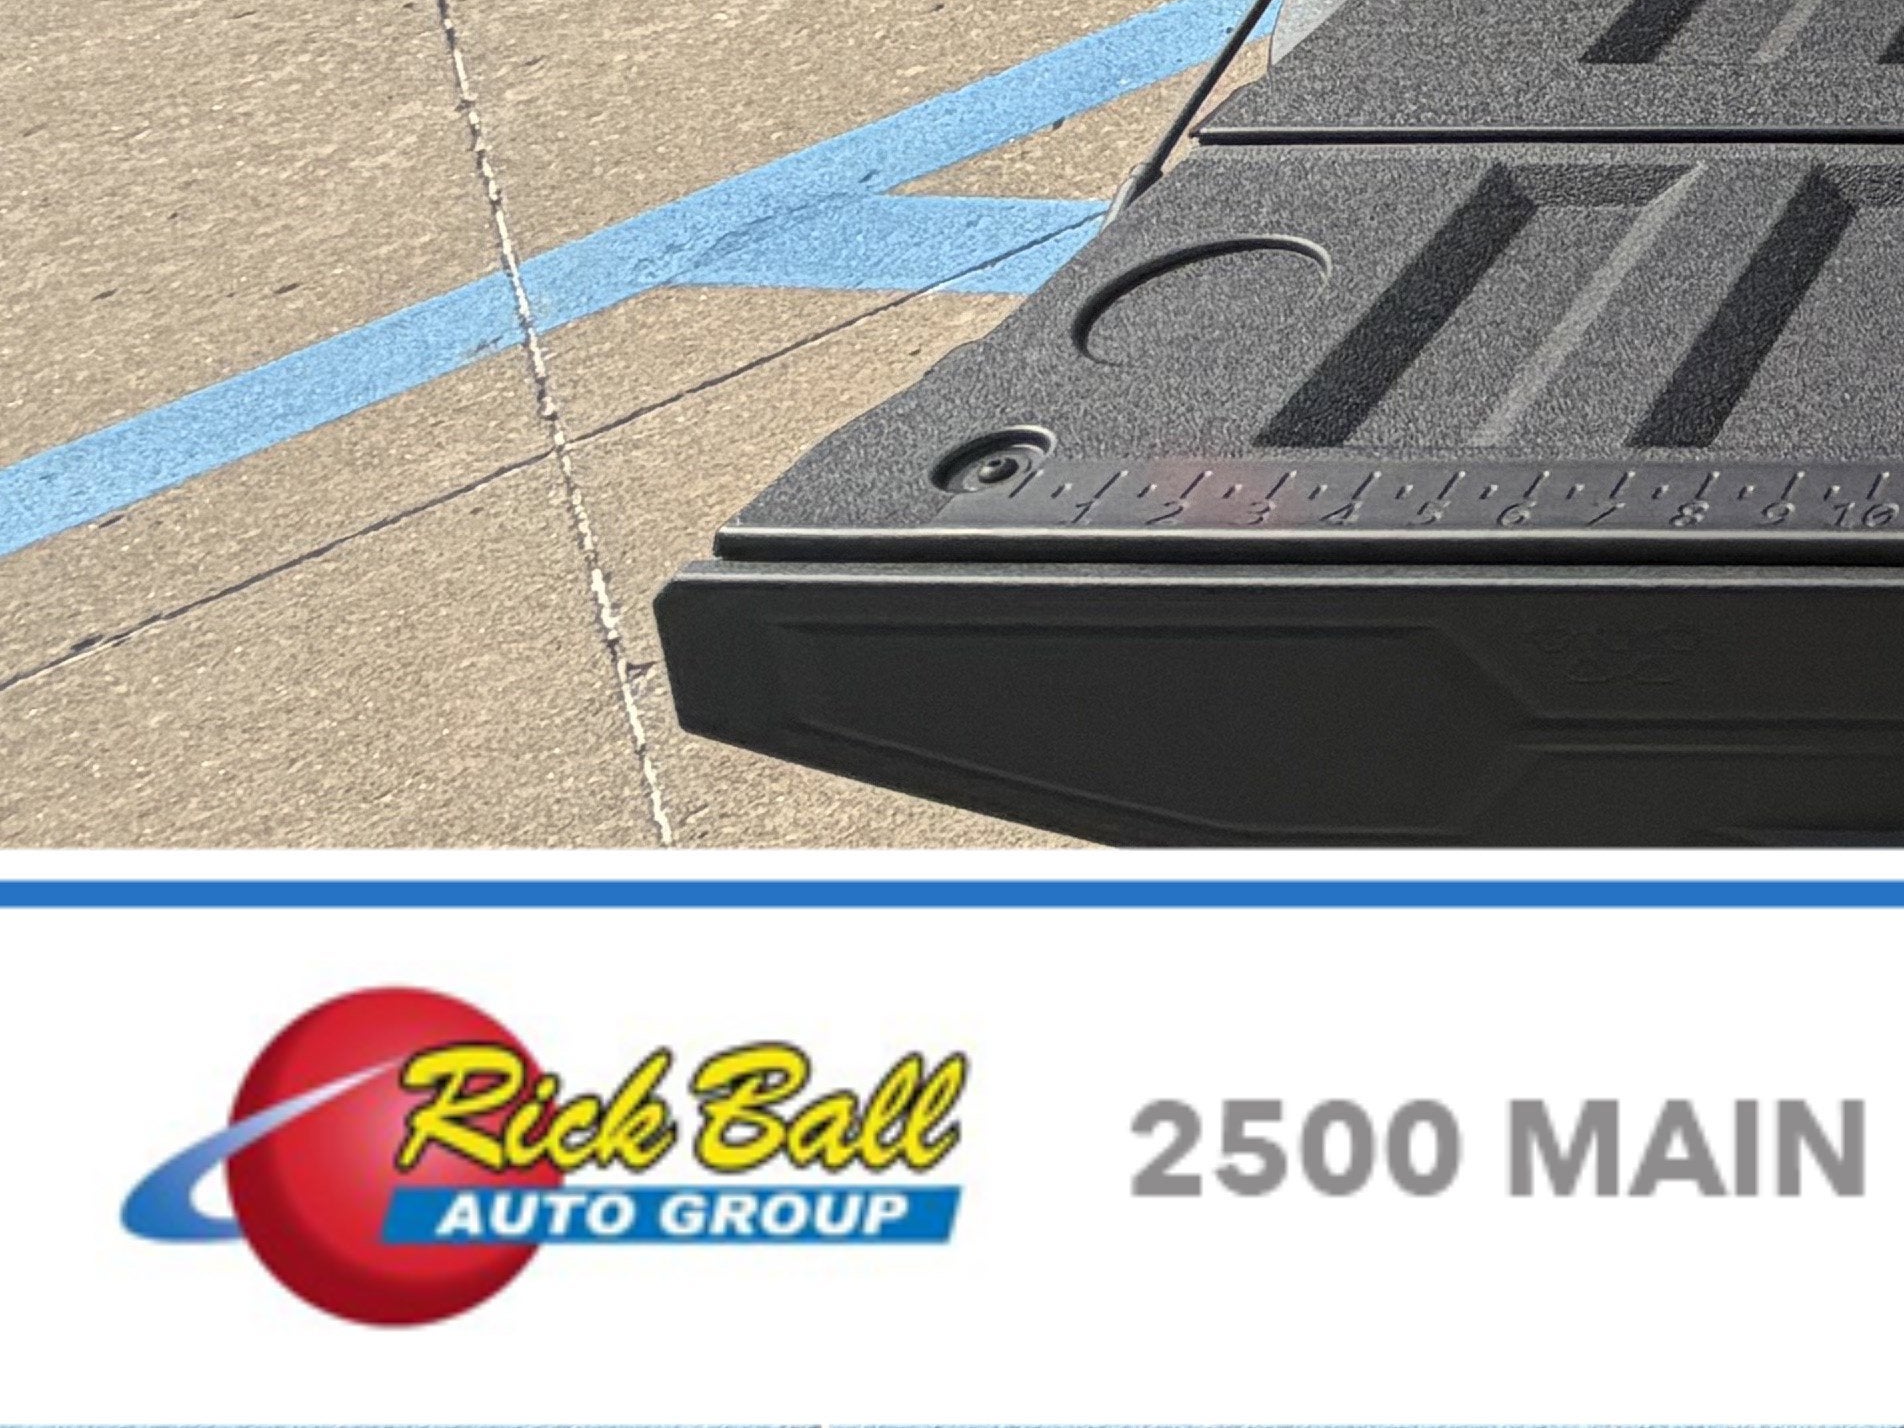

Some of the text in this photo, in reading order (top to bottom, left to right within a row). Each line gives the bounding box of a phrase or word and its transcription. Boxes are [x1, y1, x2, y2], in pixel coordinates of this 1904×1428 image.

[1062, 501, 1097, 525] 1
[1144, 501, 1190, 525] 2
[1244, 501, 1276, 525] 3
[1319, 501, 1361, 526] 4
[1410, 501, 1450, 526] 5
[1495, 501, 1537, 526] 6
[1587, 501, 1625, 527] 7
[1669, 501, 1709, 527] 8
[1755, 501, 1796, 527] 9
[1834, 503, 1899, 528] 10
